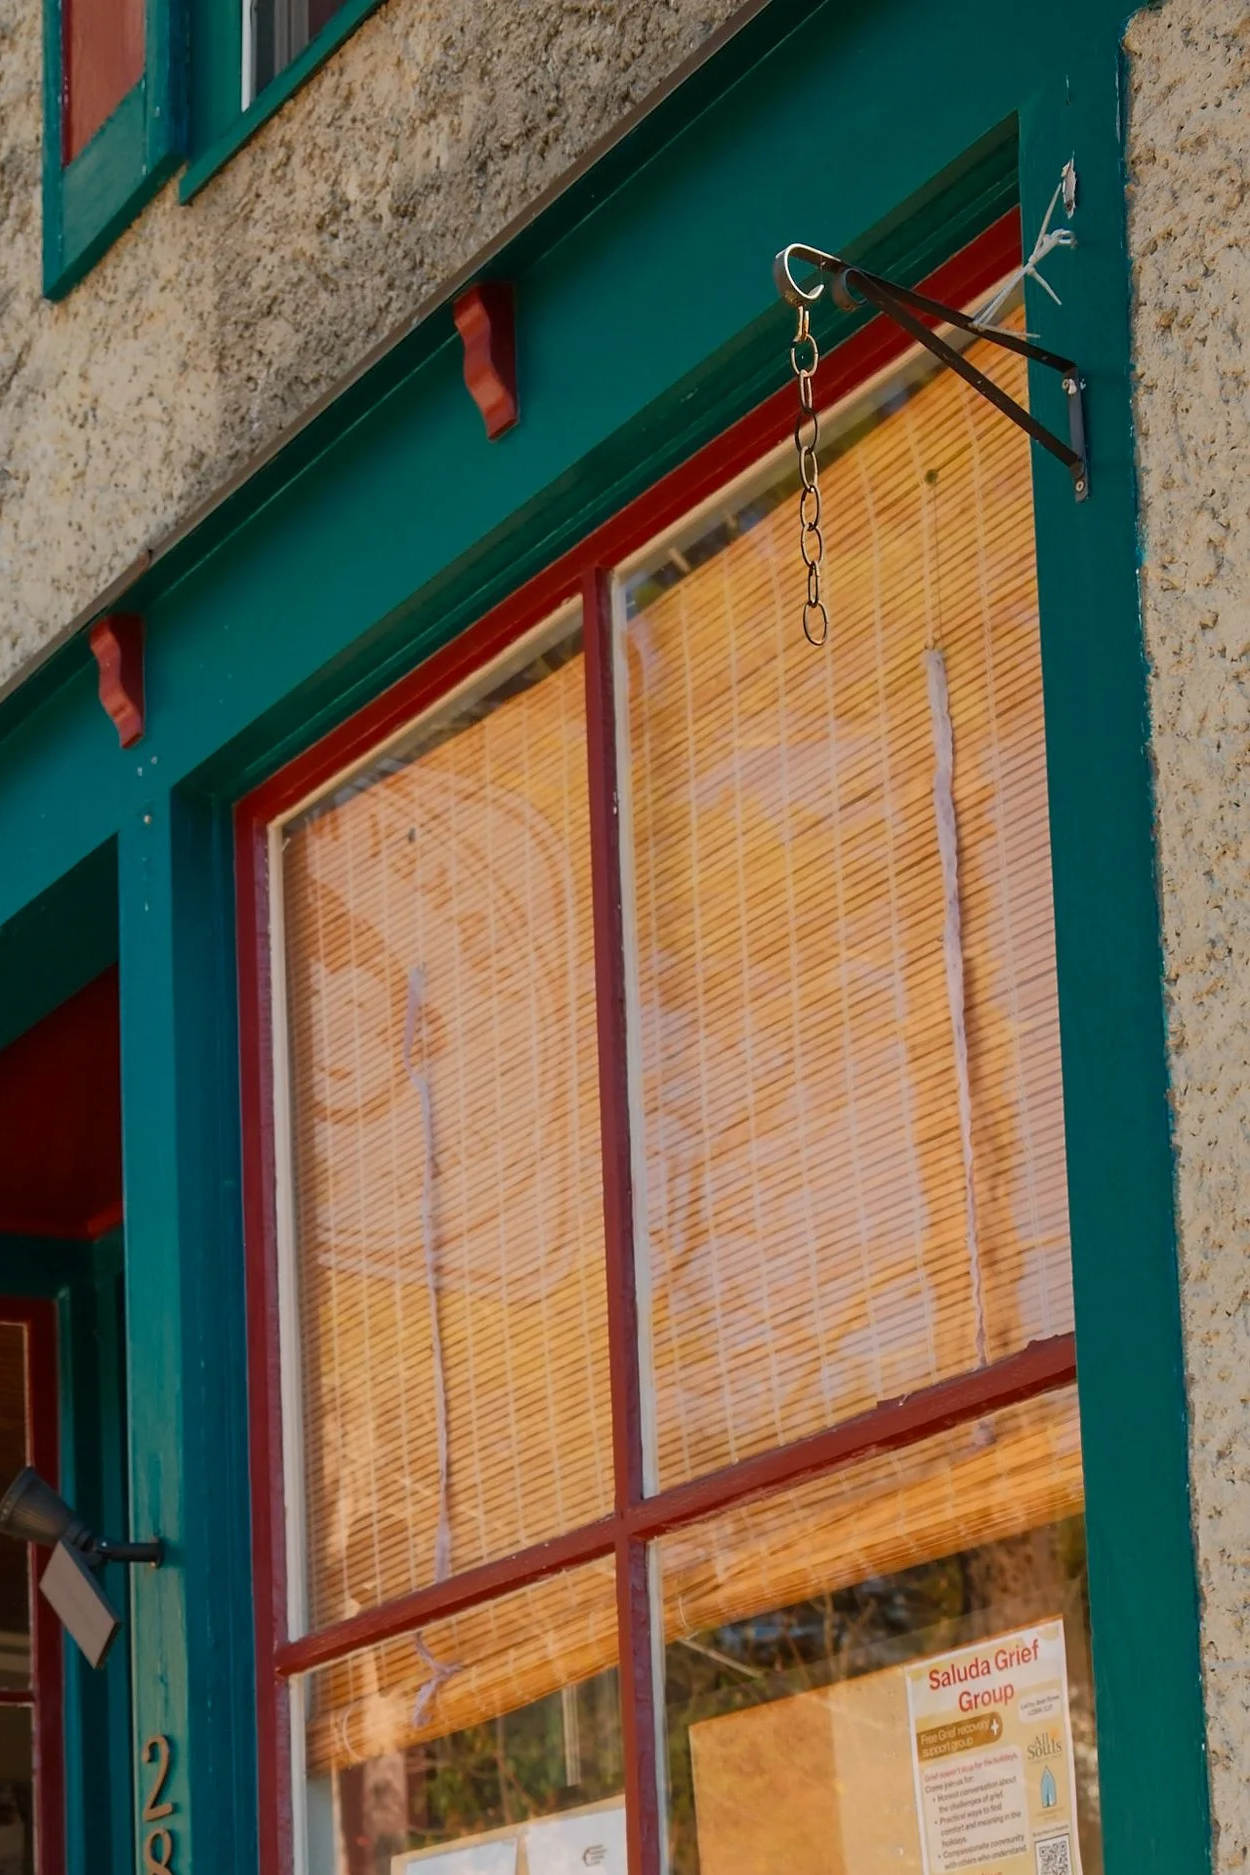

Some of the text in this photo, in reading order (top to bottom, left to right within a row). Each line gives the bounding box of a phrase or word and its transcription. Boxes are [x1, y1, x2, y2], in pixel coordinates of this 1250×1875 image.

[929, 1638, 1039, 1690] Saluda Grief
[958, 1684, 1015, 1713] Group
[921, 1733, 937, 1745] Free
[1027, 1739, 1062, 1760] Souls
